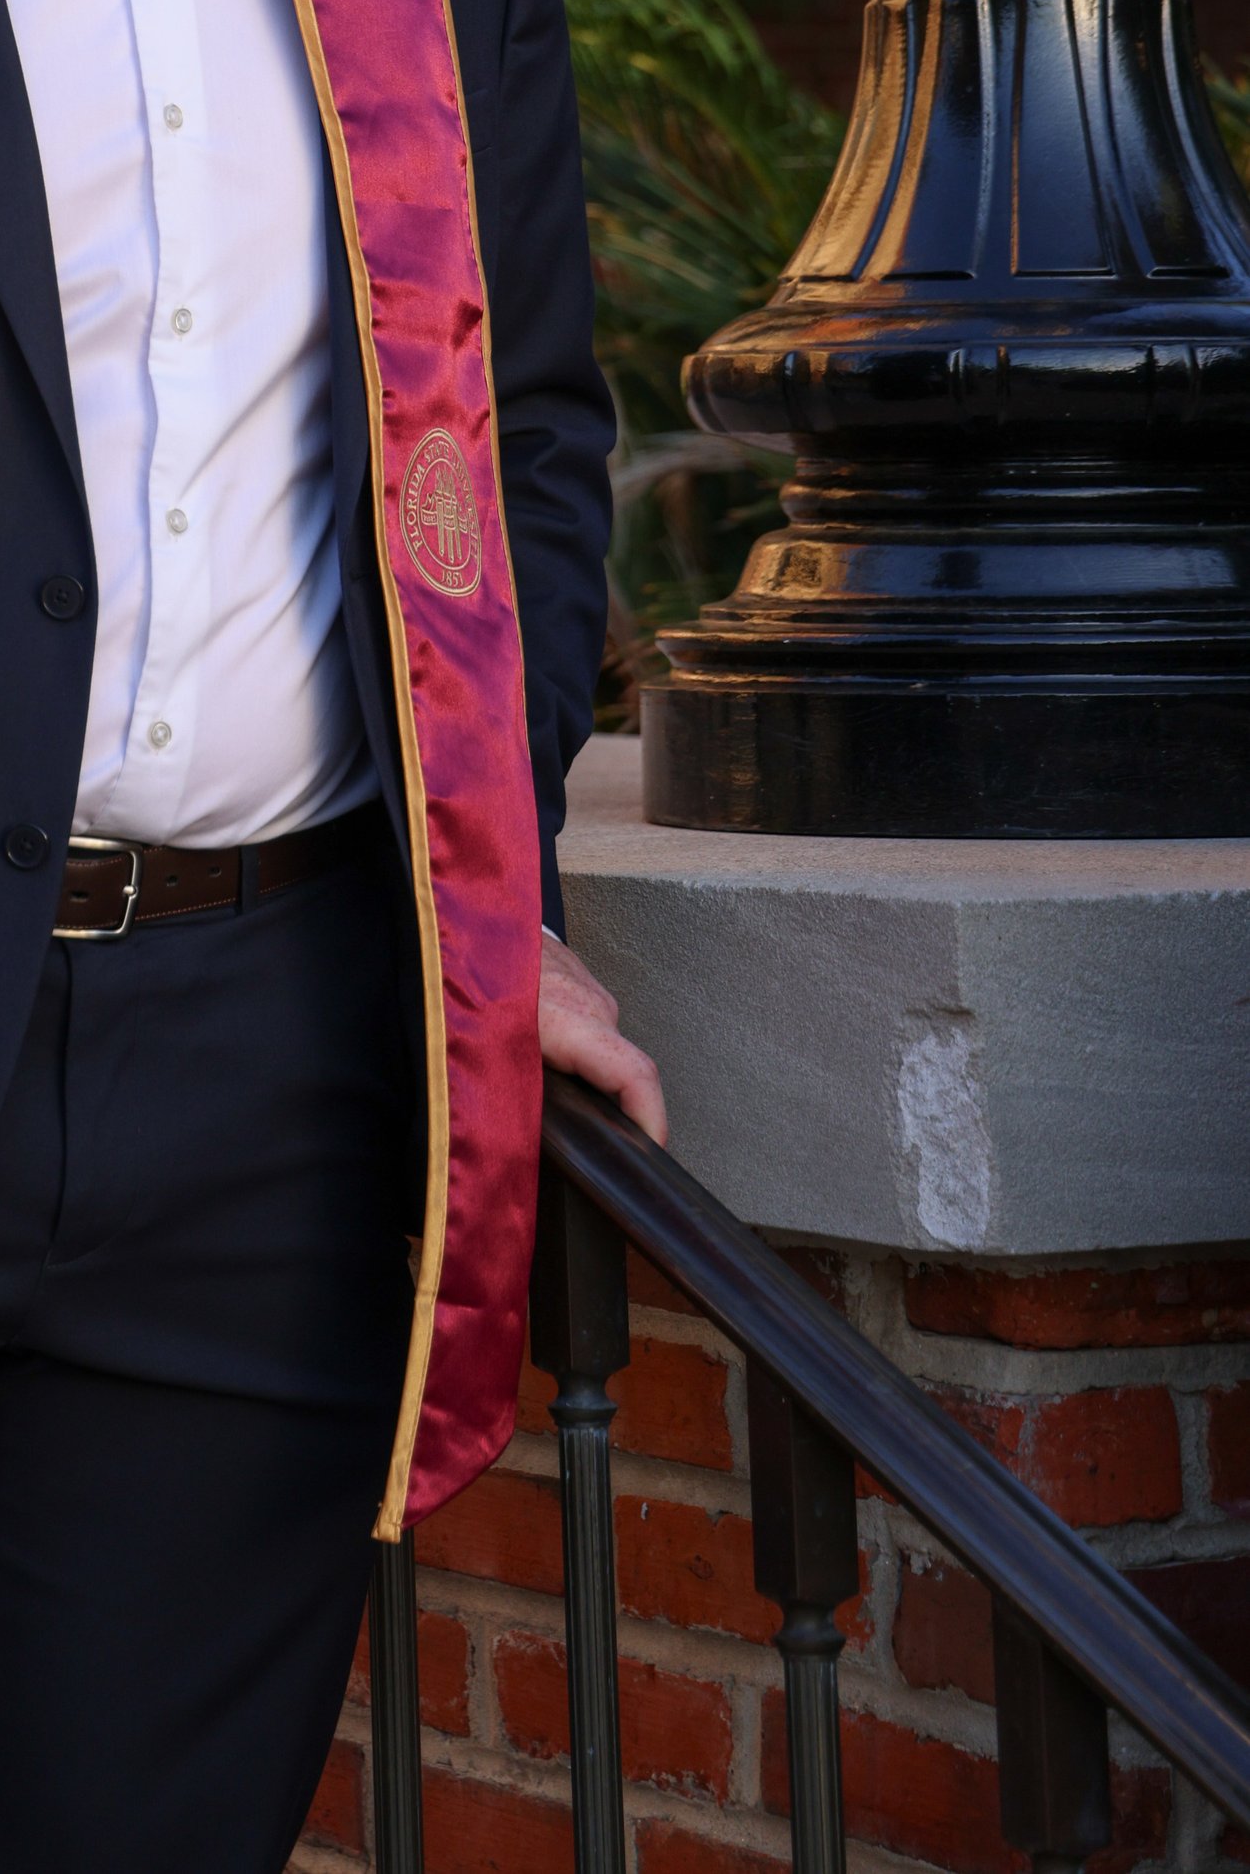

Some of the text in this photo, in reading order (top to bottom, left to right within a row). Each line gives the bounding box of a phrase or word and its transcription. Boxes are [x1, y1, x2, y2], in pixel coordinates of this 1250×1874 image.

[406, 463, 425, 552] FLORIDA
[424, 440, 450, 463] STATE
[441, 570, 464, 587] 1851
